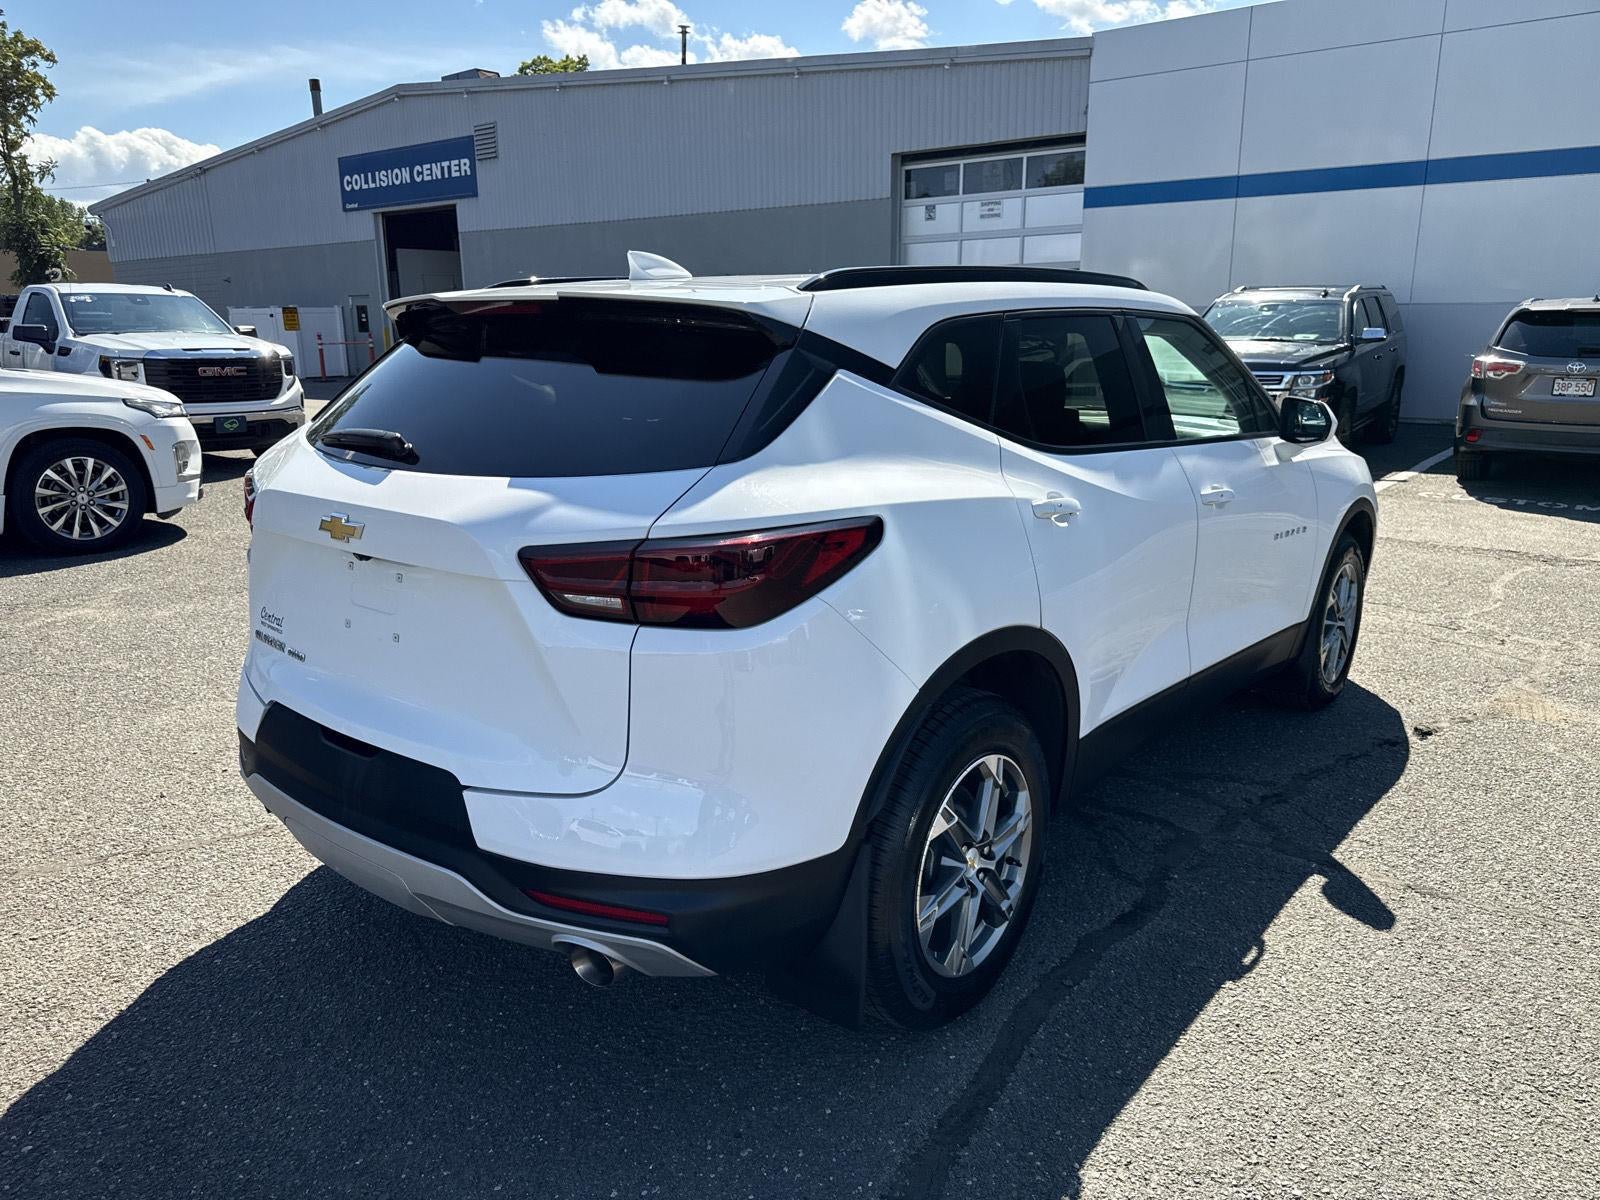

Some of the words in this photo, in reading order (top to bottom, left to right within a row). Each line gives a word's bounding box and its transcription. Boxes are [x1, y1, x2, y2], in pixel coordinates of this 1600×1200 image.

[343, 166, 411, 191] COLLISION
[413, 158, 471, 183] CENTER
[198, 366, 247, 377] GMC
[1554, 382, 1572, 392] 38P
[1574, 382, 1593, 393] 550
[260, 606, 285, 628] Central
